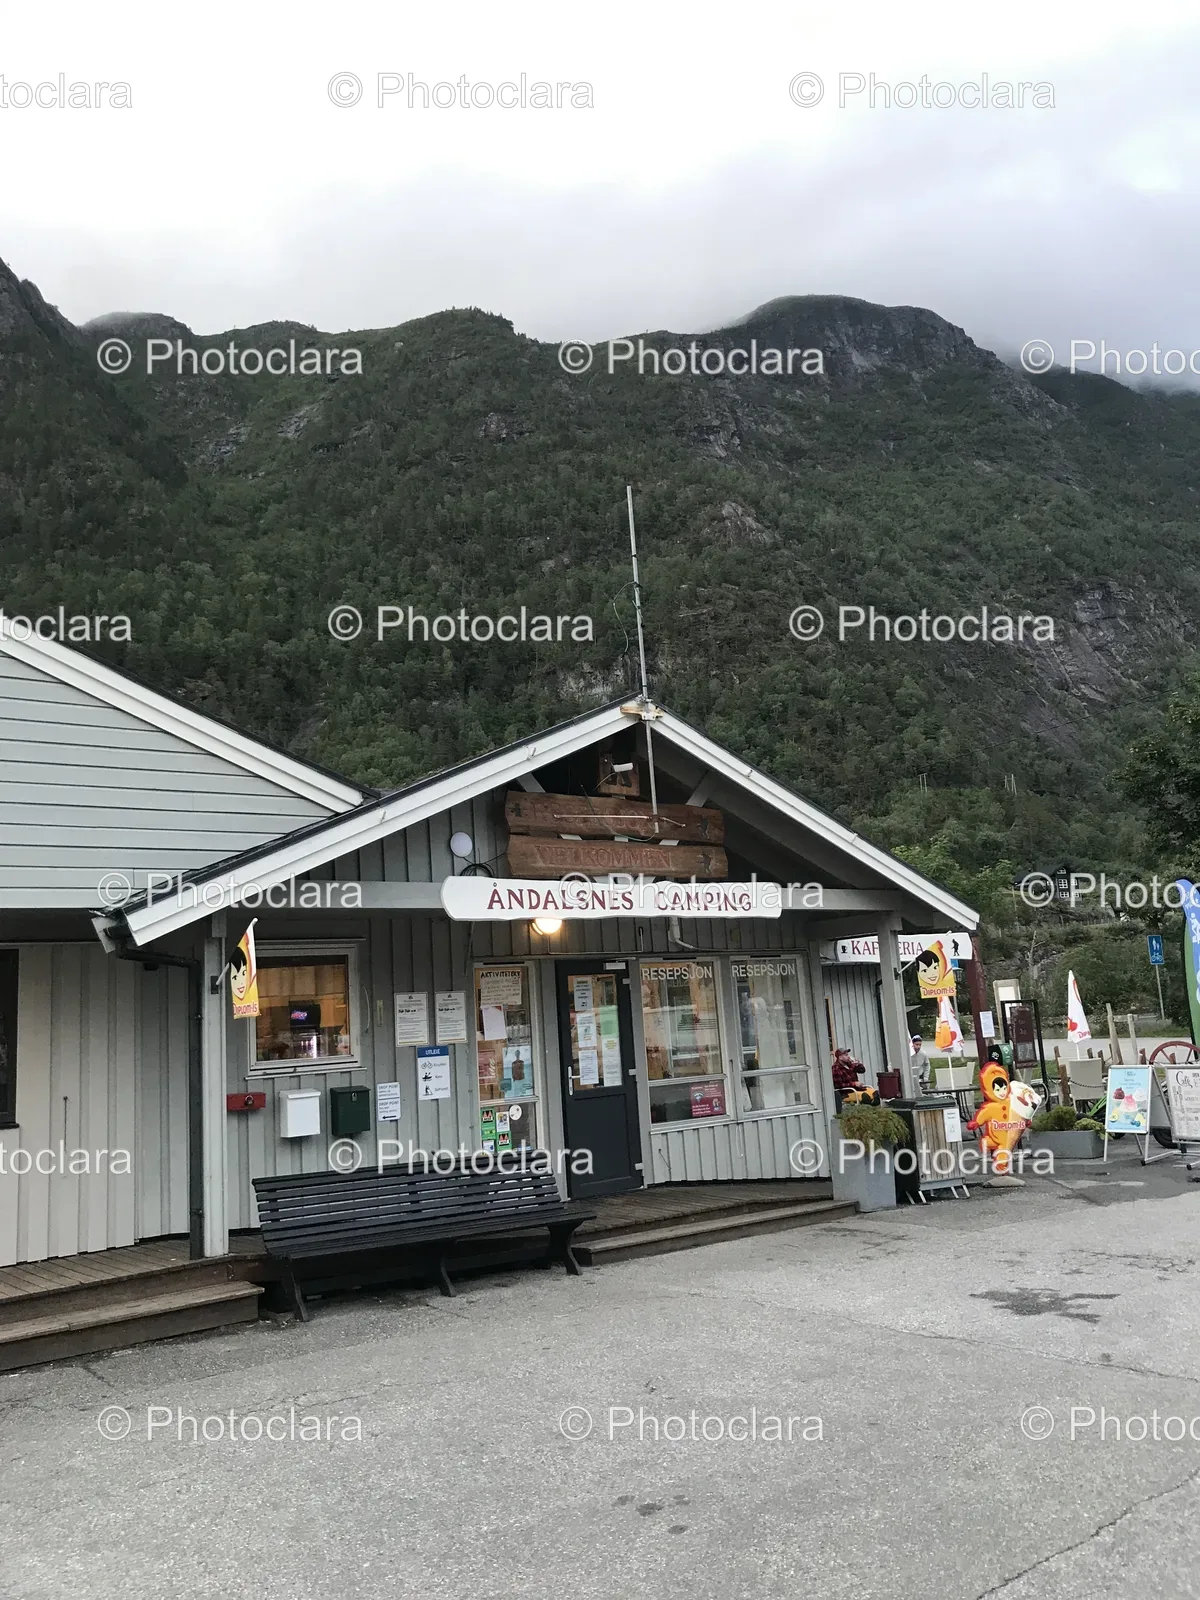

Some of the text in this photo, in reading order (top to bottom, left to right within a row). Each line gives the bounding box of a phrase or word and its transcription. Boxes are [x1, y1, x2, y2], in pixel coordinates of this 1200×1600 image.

[535, 845, 671, 868] VELKOMMEN
[487, 882, 752, 911] ÅNDALSNES CAMPING
[851, 940, 924, 955] KAFERIA
[641, 966, 713, 980] RESEPSJON
[732, 963, 796, 977] RESEPSJON
